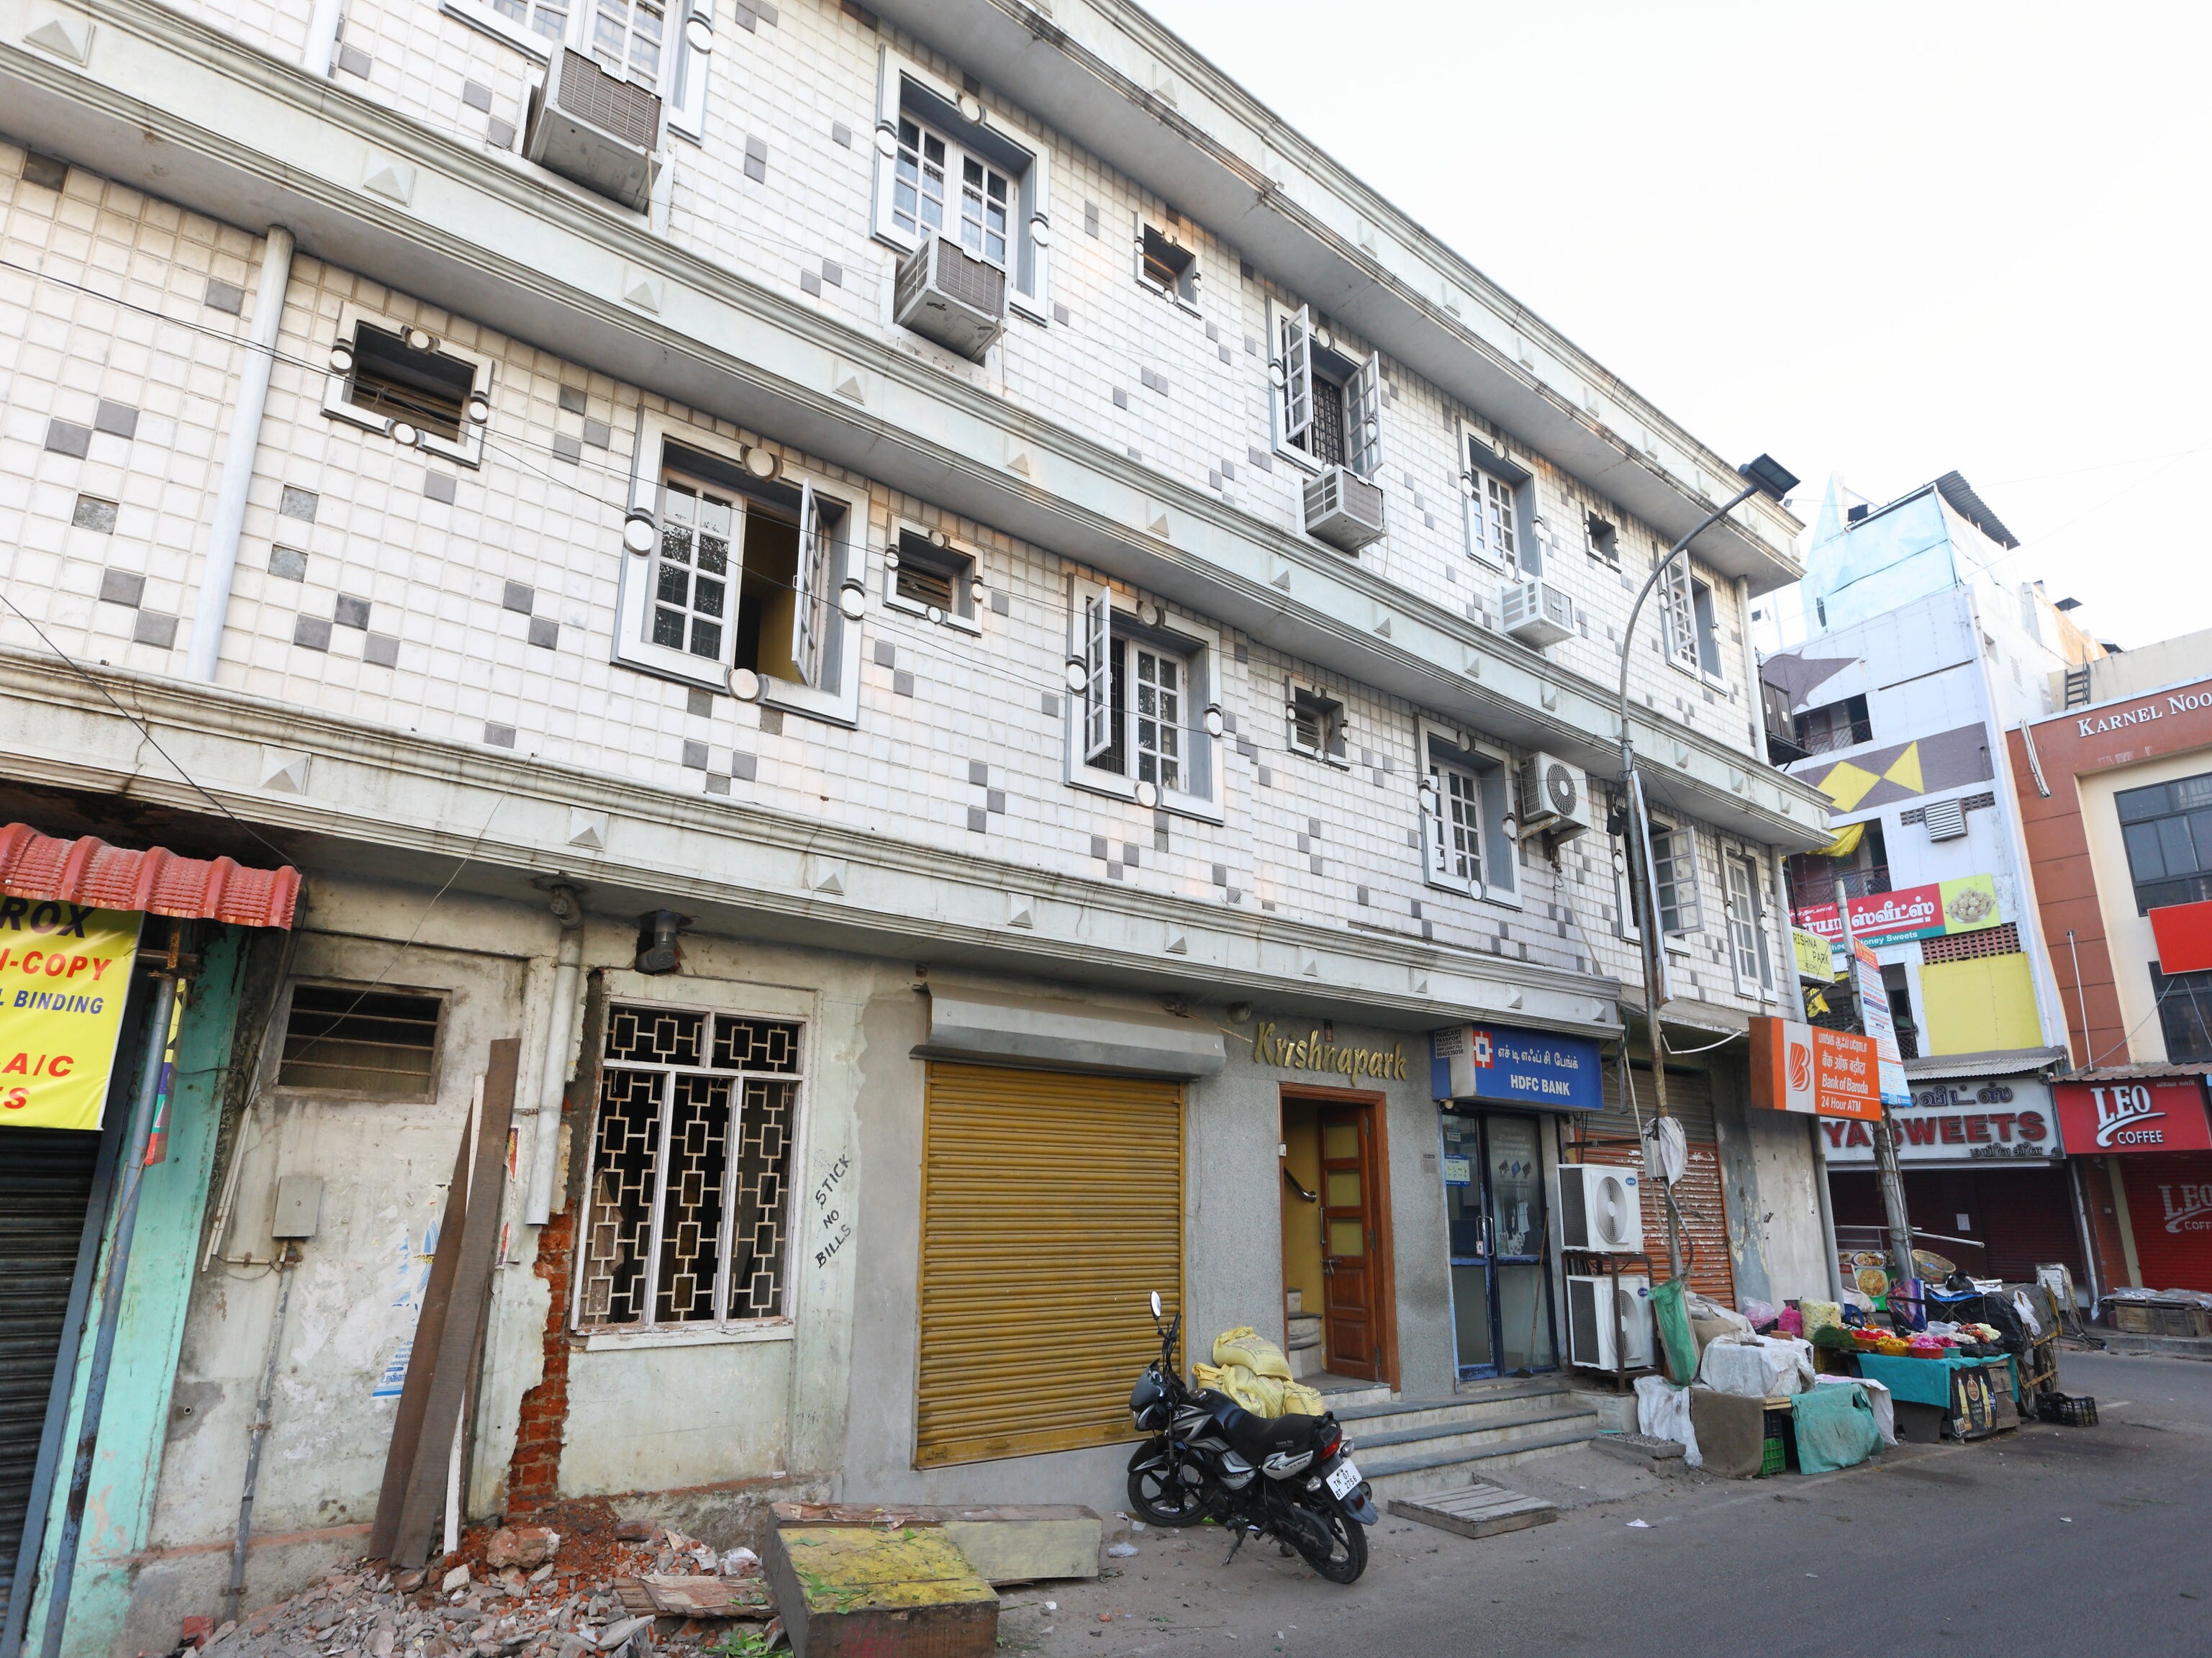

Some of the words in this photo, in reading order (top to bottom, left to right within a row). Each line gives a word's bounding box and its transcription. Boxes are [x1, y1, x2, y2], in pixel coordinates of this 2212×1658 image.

[2077, 705, 2163, 738] KARNEL
[2167, 692, 2212, 715] NOO
[0, 896, 96, 938] ROX
[1886, 931, 1918, 942] Sweets
[1813, 951, 1830, 965] PARK
[14, 989, 104, 1015] BINDING
[1, 1053, 75, 1077] A/C
[1254, 1021, 1408, 1087] Krishnapark
[1510, 1074, 1539, 1092] HDFC
[1541, 1079, 1571, 1096] BANK
[1822, 1073, 1839, 1090] Bank
[1839, 1077, 1846, 1090] of
[1846, 1077, 1868, 1094] Baroda
[1821, 1095, 1830, 1108] 24
[1831, 1097, 1846, 1110] Hour
[1847, 1100, 1861, 1112] ATM
[2090, 1084, 2152, 1131] LEO
[2117, 1130, 2164, 1145] COFFEE
[815, 1153, 852, 1210] STICK
[822, 1209, 839, 1229] NO
[815, 1224, 851, 1269] BILLS
[1333, 1477, 1342, 1487] TN
[1343, 1469, 1350, 1480] 07
[1335, 1488, 1343, 1497] BT
[1344, 1475, 1357, 1490] 2756
